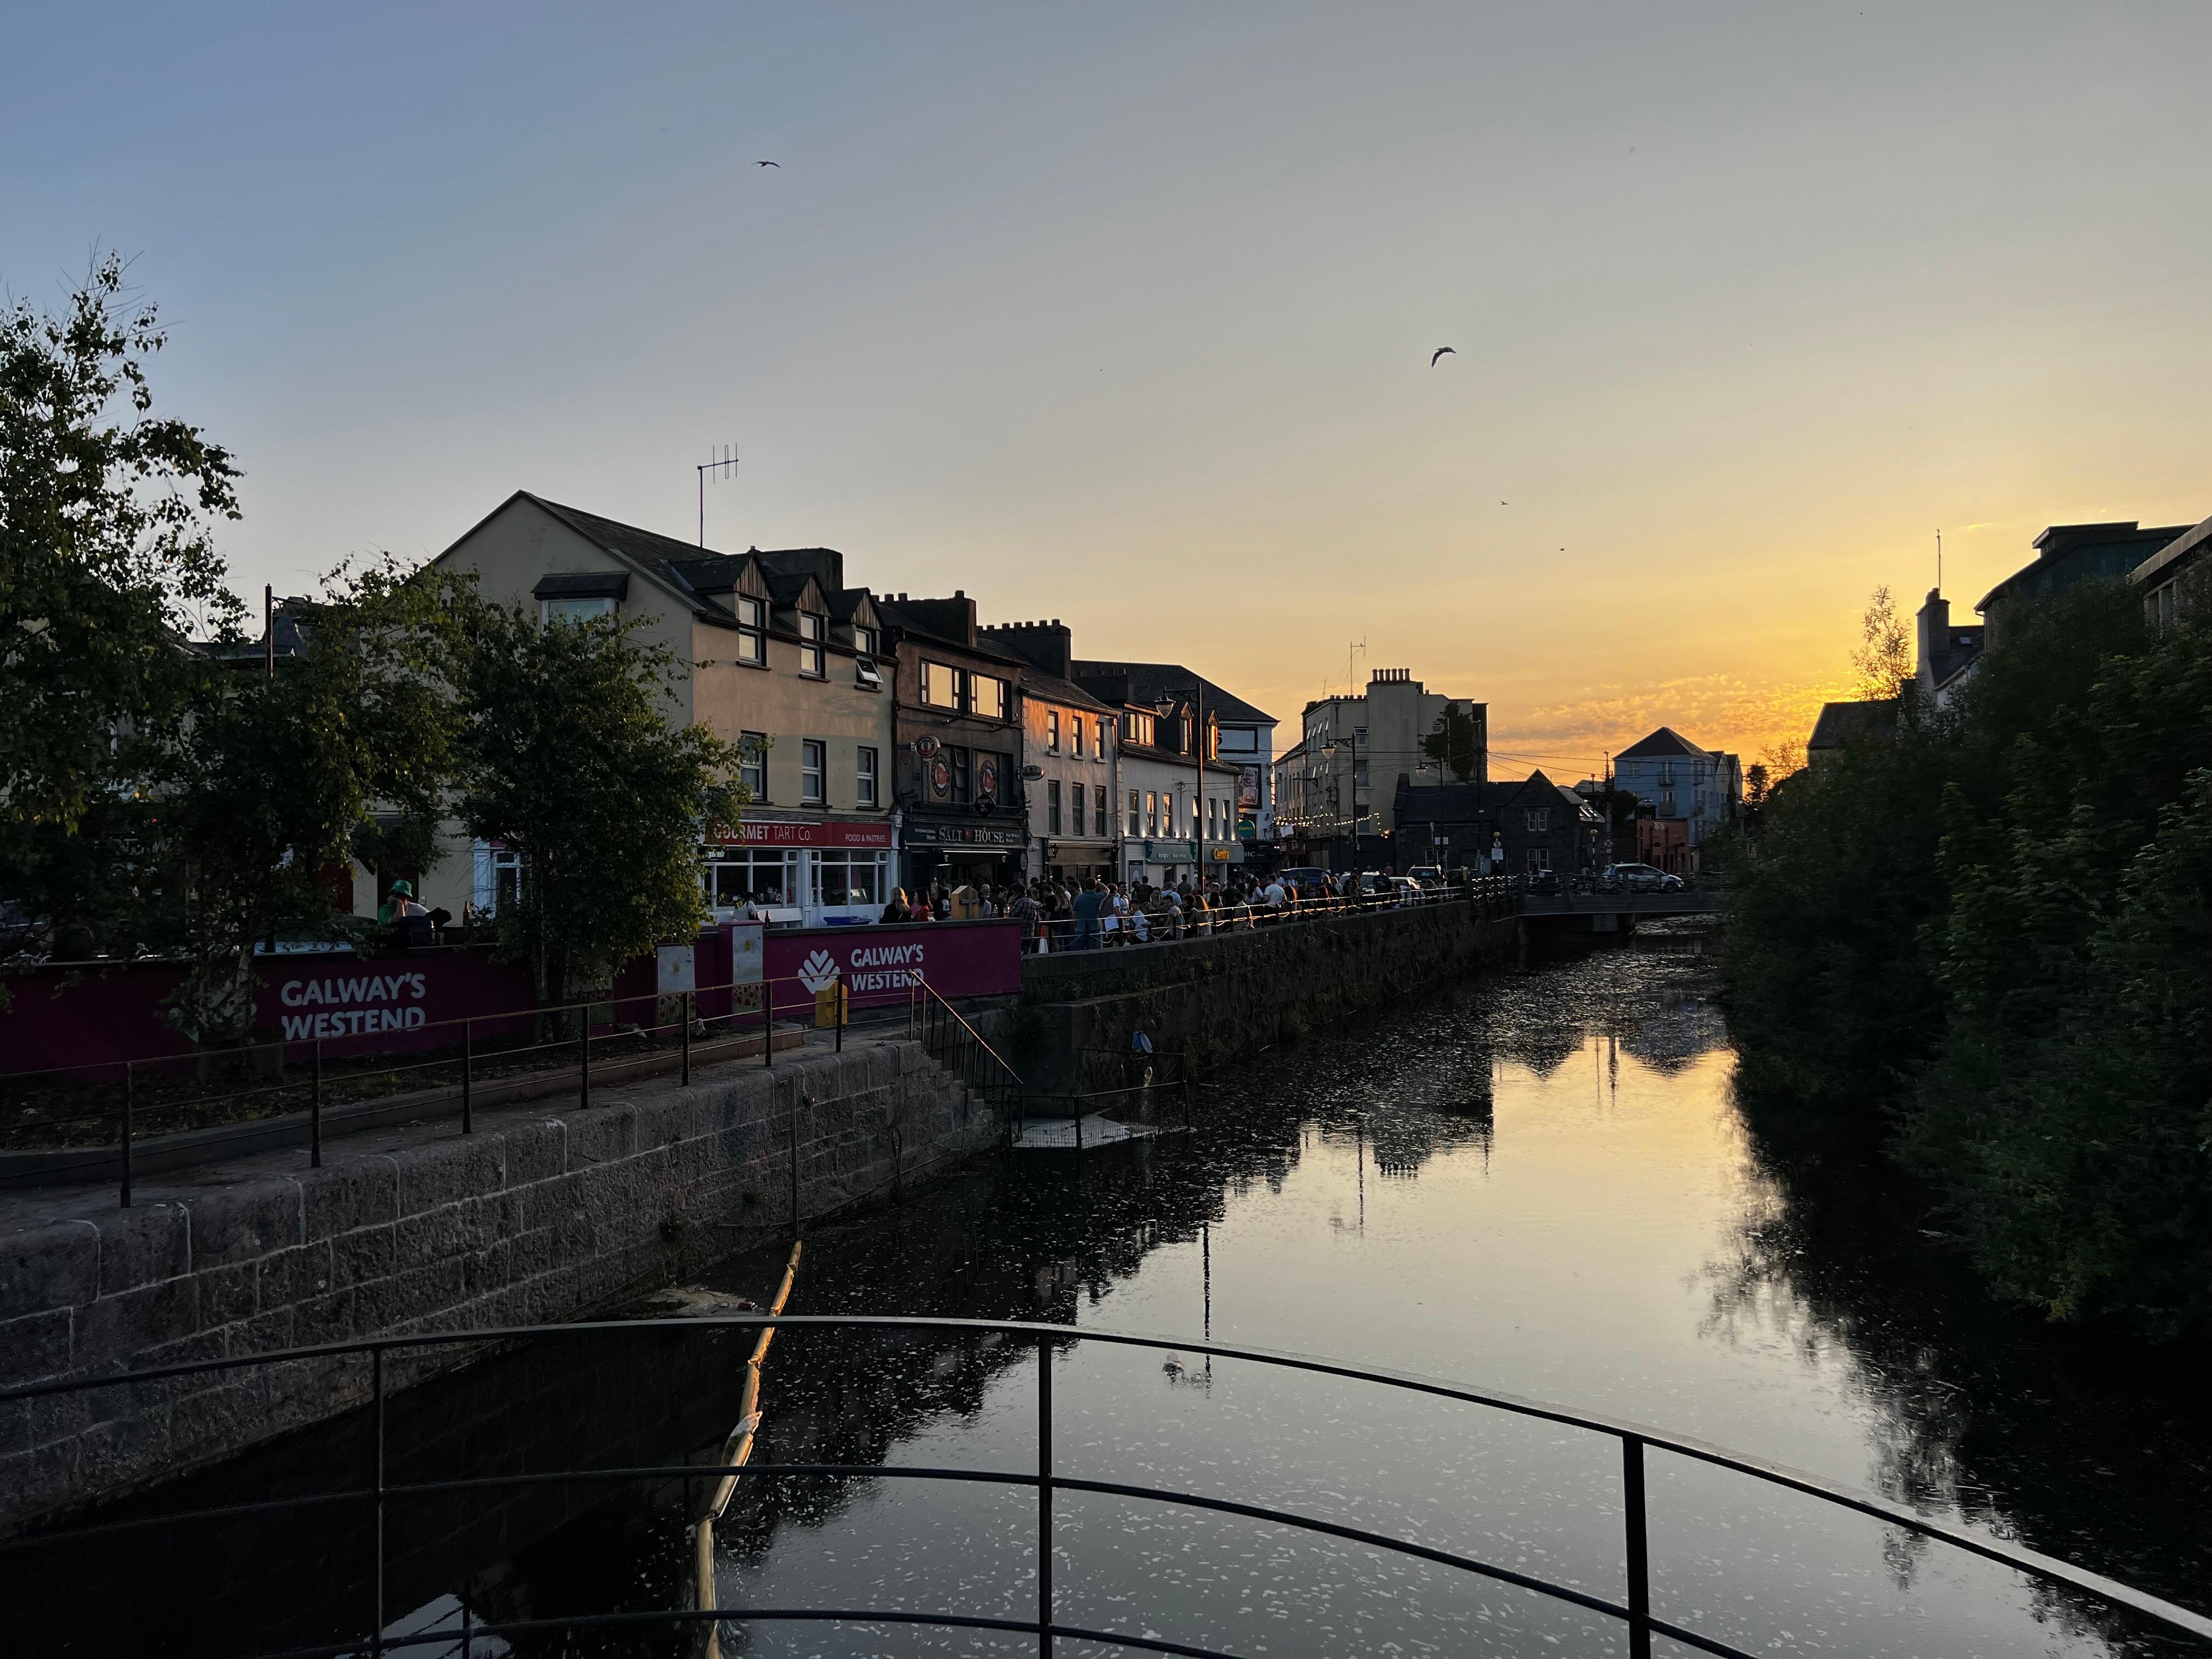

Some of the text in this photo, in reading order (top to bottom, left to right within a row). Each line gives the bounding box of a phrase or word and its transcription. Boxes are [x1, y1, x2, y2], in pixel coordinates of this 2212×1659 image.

[772, 826, 795, 840] TART
[798, 826, 812, 841] Co.
[866, 834, 886, 843] PASTRIES
[939, 827, 1005, 843] SALT HOUSE
[1213, 848, 1229, 861] Centra
[851, 943, 924, 968] GALWAY'S
[280, 972, 426, 1007] GALWAY'S
[851, 968, 924, 992] WESTEND
[280, 1006, 426, 1041] WESTEND
